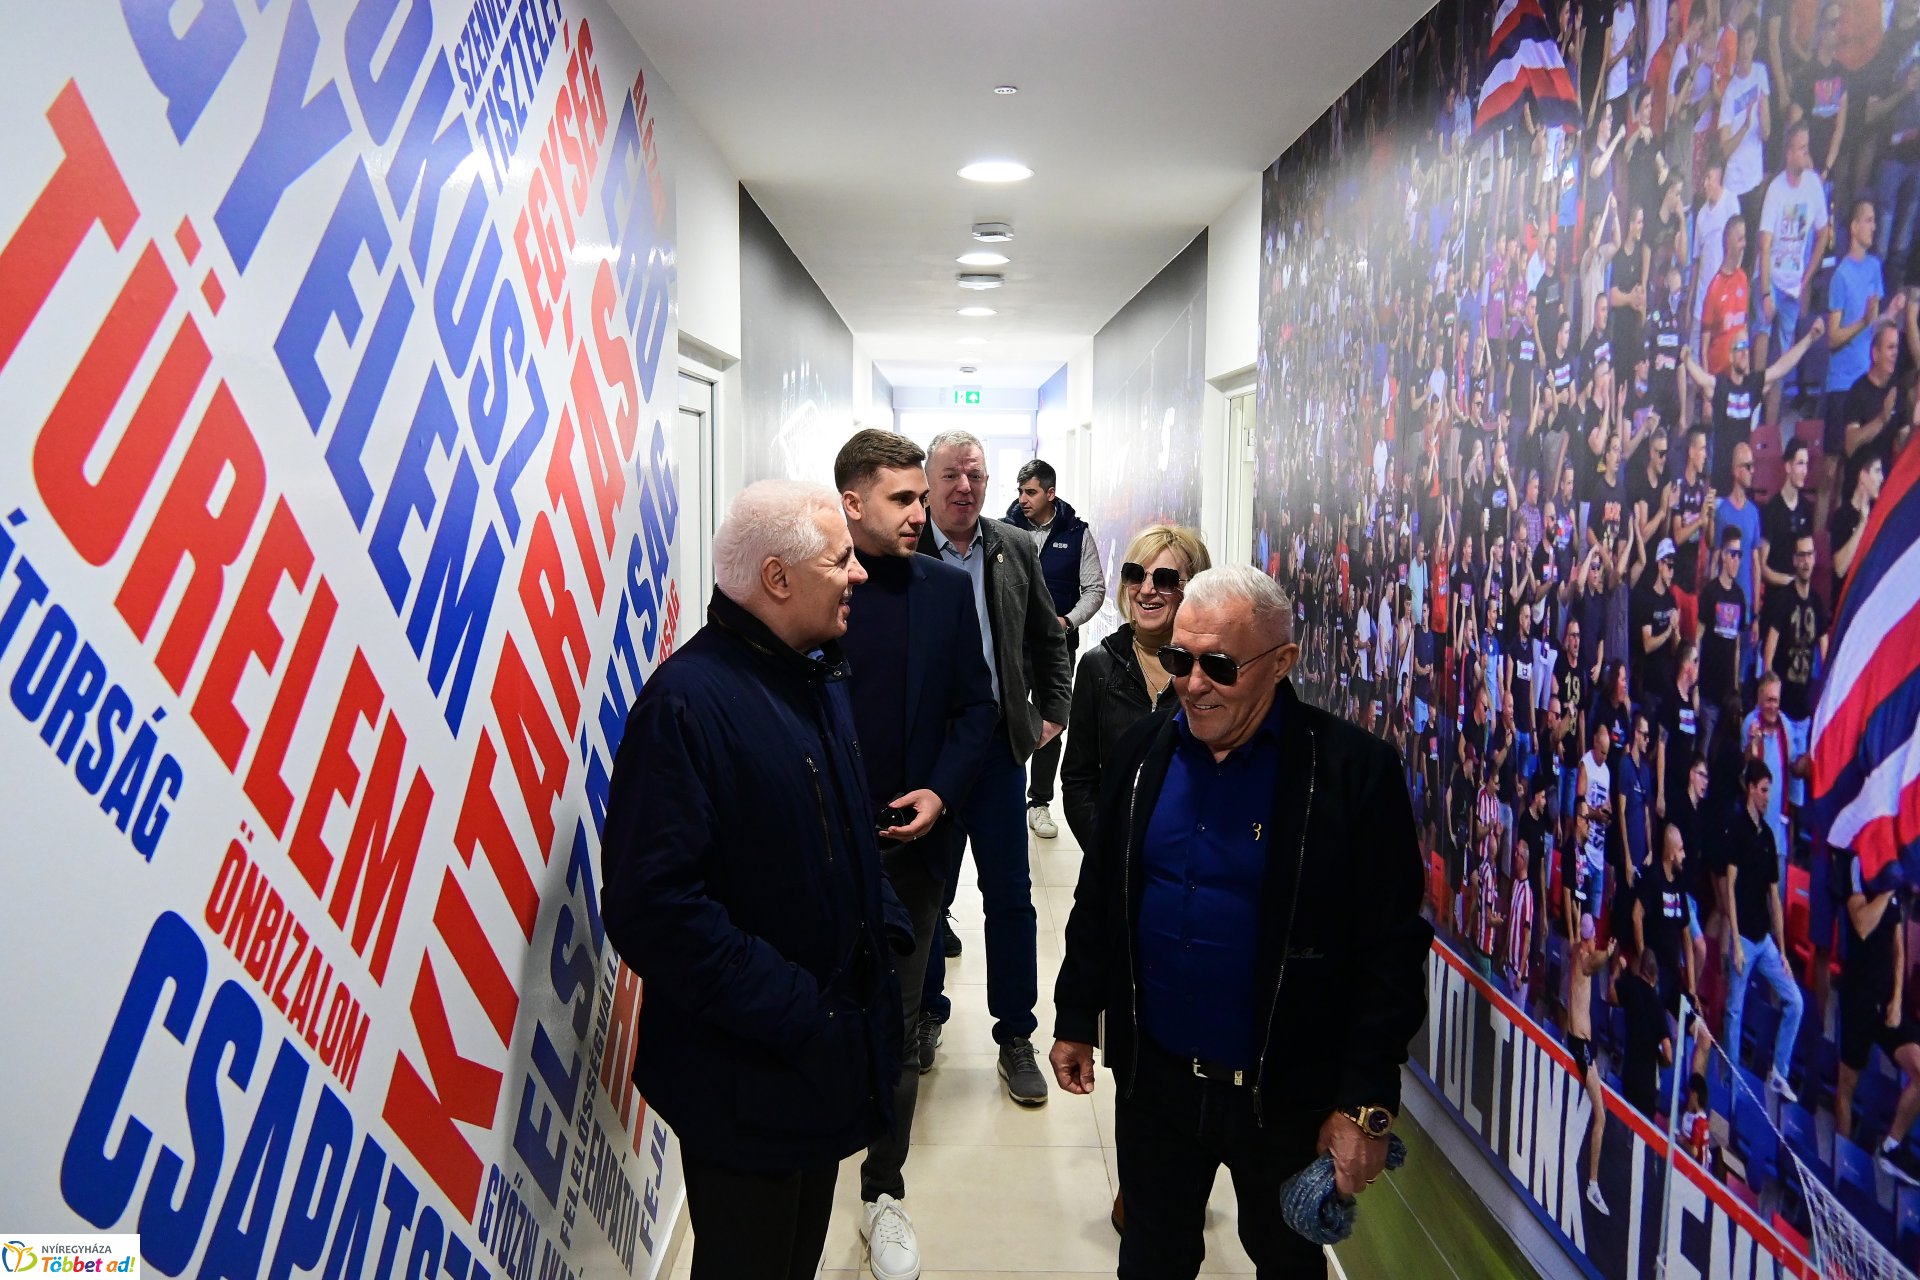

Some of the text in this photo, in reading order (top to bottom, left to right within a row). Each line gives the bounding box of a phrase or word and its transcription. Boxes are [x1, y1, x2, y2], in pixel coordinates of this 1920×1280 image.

[513, 18, 608, 349] EGYSÉG
[0, 77, 434, 988] TÜRELEM
[0, 508, 183, 863] TORSÁG
[382, 258, 639, 1224] KITARTÁS
[204, 820, 371, 1093] ÖNBIZALOM
[582, 1118, 640, 1277] EMPÁTIA
